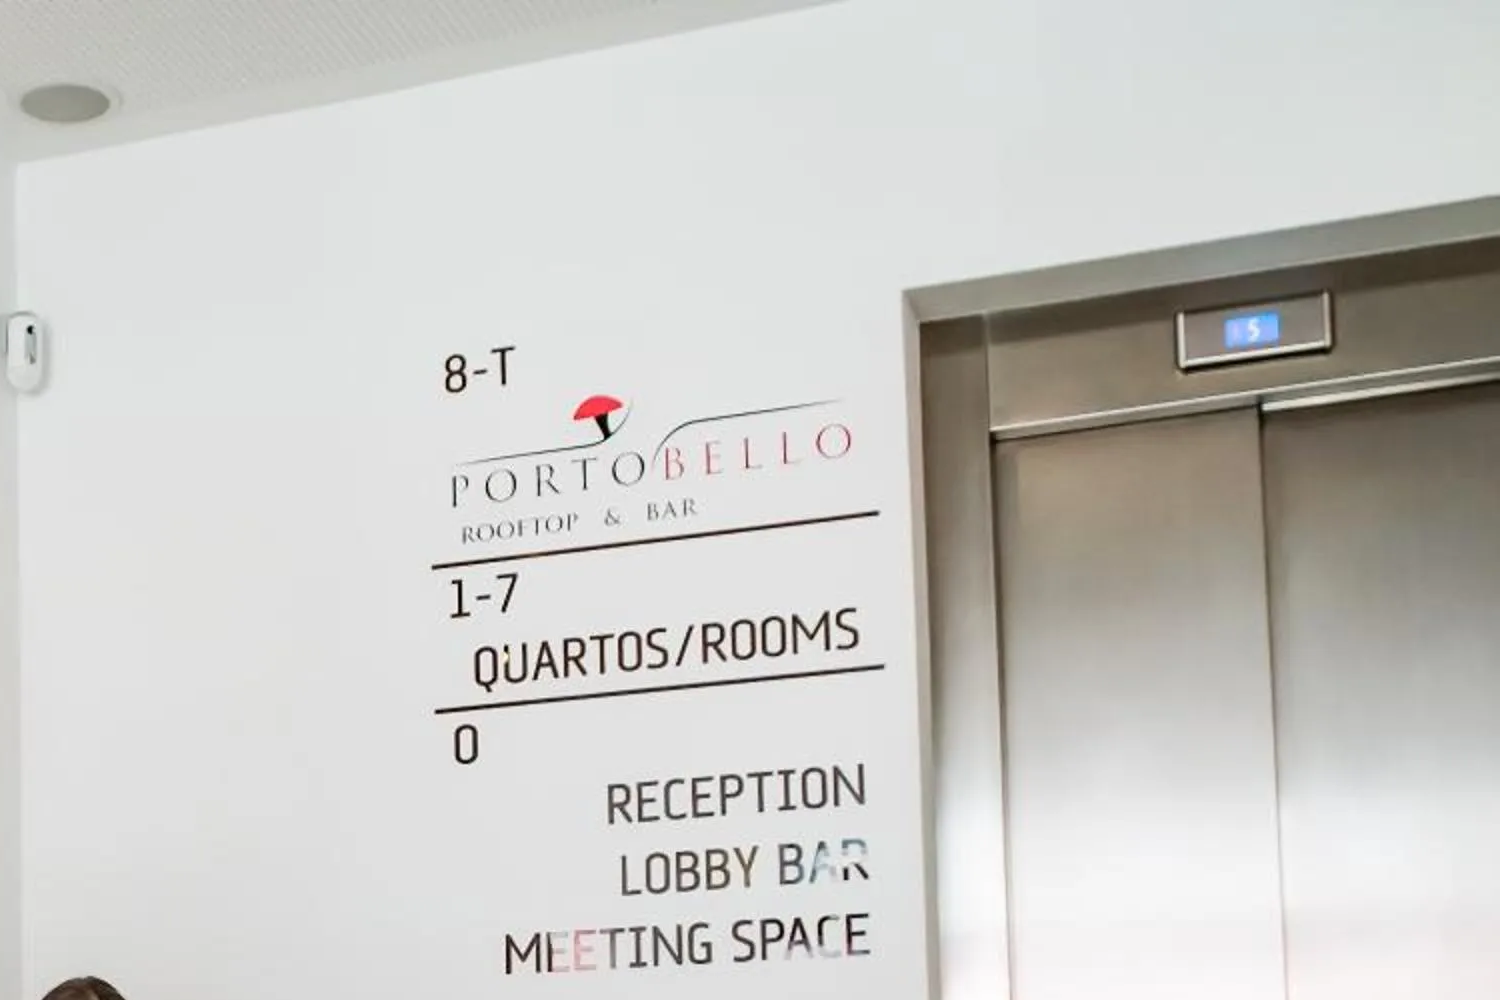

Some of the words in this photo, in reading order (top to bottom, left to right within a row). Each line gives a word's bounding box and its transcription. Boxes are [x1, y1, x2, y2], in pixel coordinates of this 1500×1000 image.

[444, 345, 516, 394] 8-T
[450, 423, 853, 508] PORTOBELLO
[461, 512, 580, 545] ROOFTOP
[604, 508, 621, 527] &
[646, 498, 698, 521] BAR
[449, 572, 519, 619] 1-7
[474, 607, 861, 693] QUARTOS/ROOMS
[607, 763, 866, 825] RECEPTION
[621, 845, 759, 896] LOBBY
[778, 838, 870, 886] BAR
[504, 922, 714, 975] MEETING
[731, 912, 871, 963] SPACE
